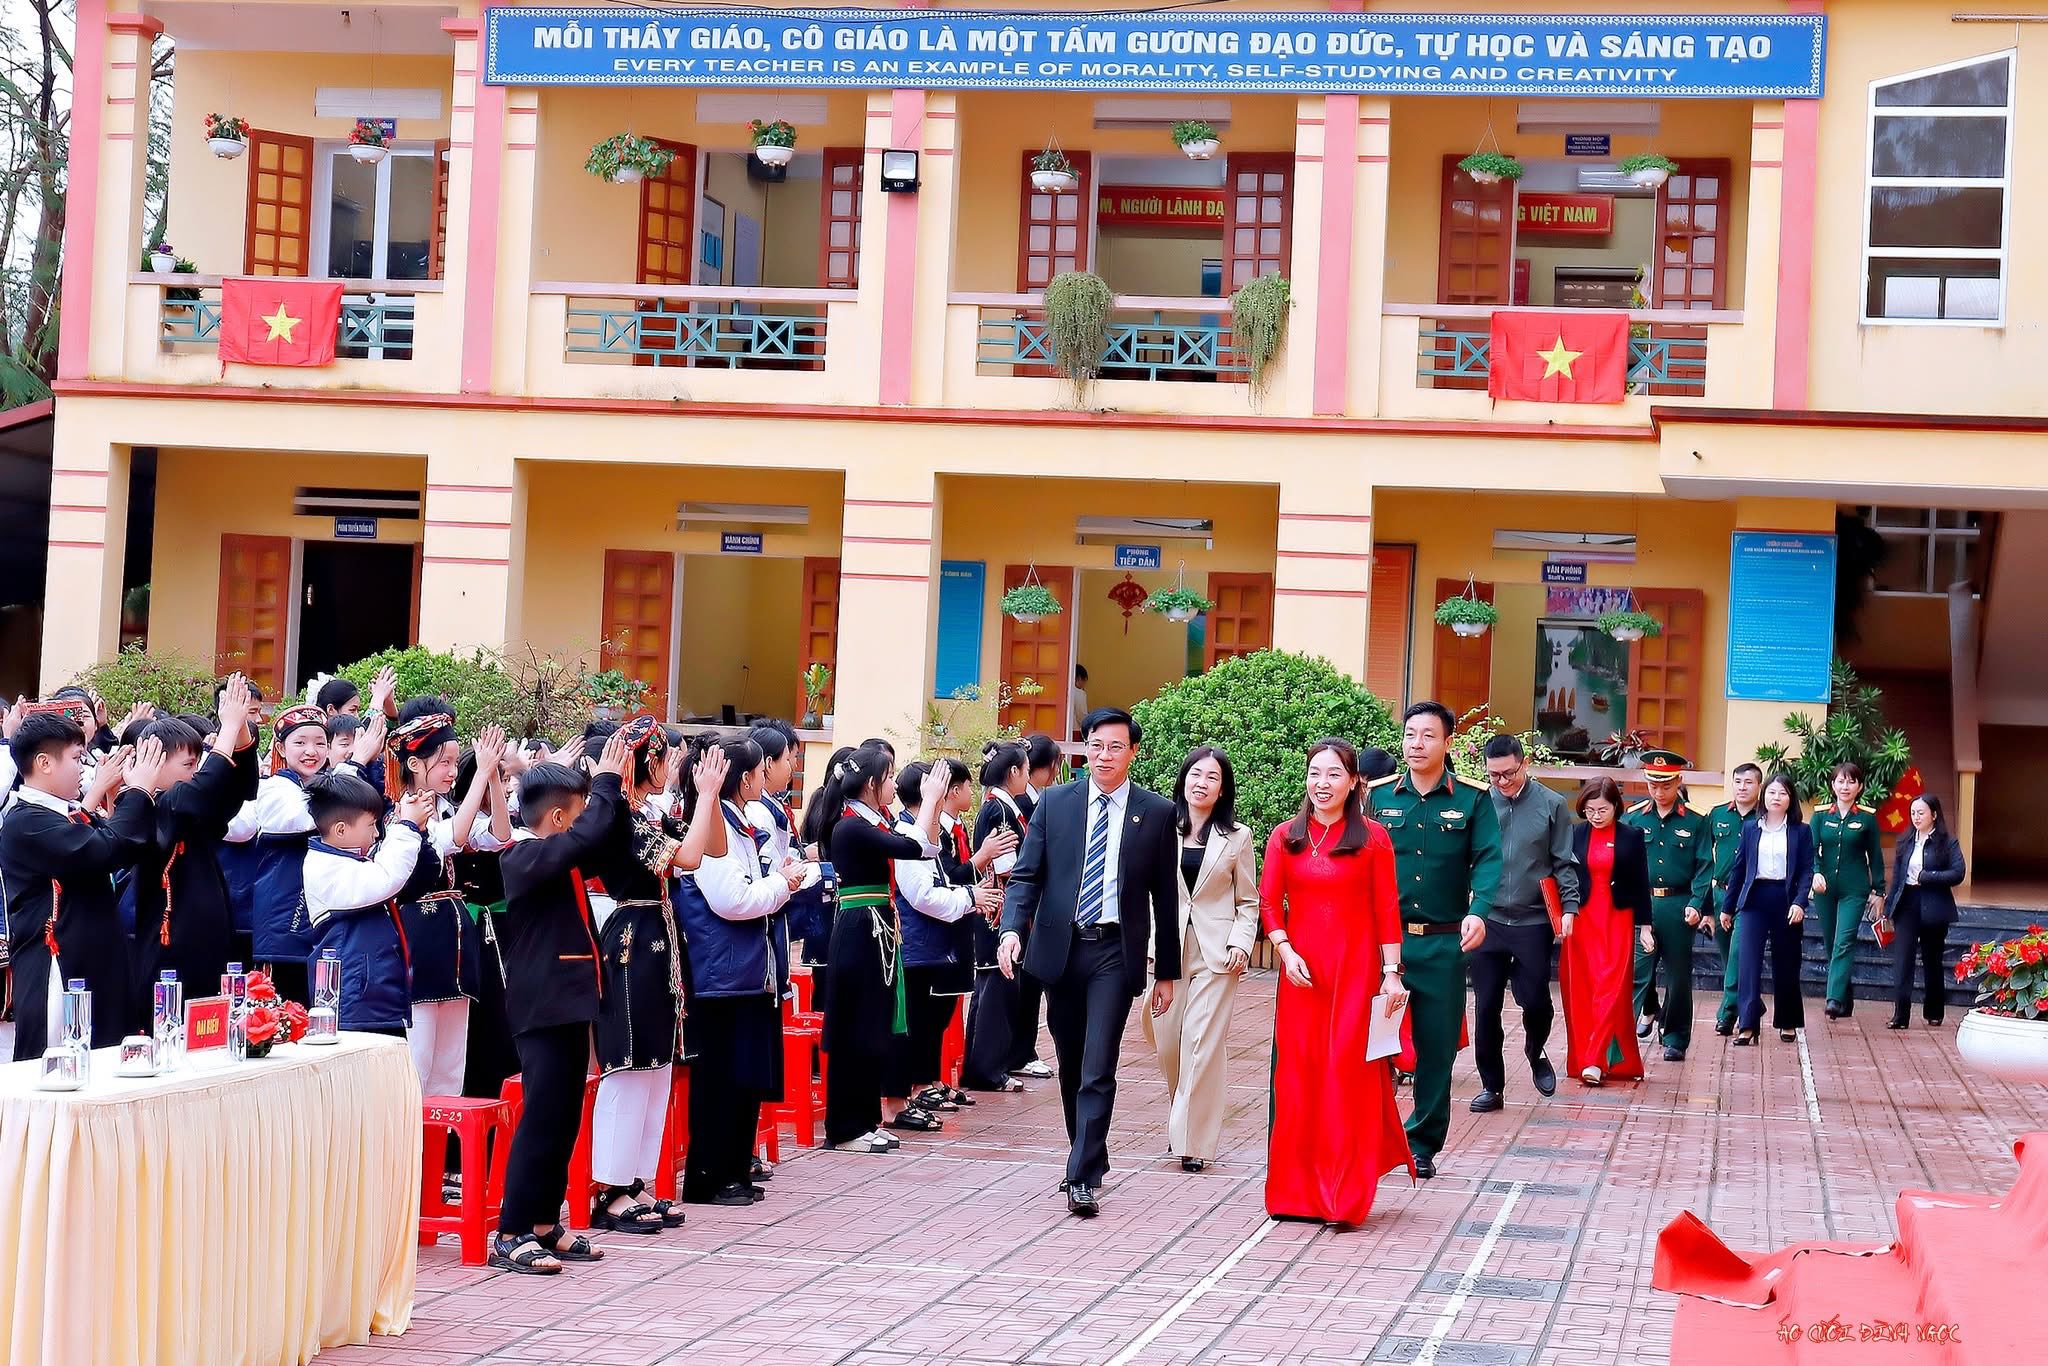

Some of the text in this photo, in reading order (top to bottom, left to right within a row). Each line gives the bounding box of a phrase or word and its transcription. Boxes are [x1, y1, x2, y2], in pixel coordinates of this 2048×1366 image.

[534, 20, 1771, 62] MỖI THẦY GIÁO, CÔ GIÁO LÀ MỘT TẤM GƯƠNG ĐẠO ĐỨC, TỰ HỌC VÀ SÁNG TẠO
[614, 59, 1677, 81] EVERY TEACHER IS AN EXAMPLE OF MORALITY, SELF-STUDYING AND CREATIVITY
[1120, 195, 1163, 215] NGƯỜI
[1166, 197, 1203, 216] LÃNH
[1530, 203, 1559, 225] VIỆT
[1563, 207, 1597, 223] NAM
[1120, 554, 1156, 567] TIẾP DÂN
